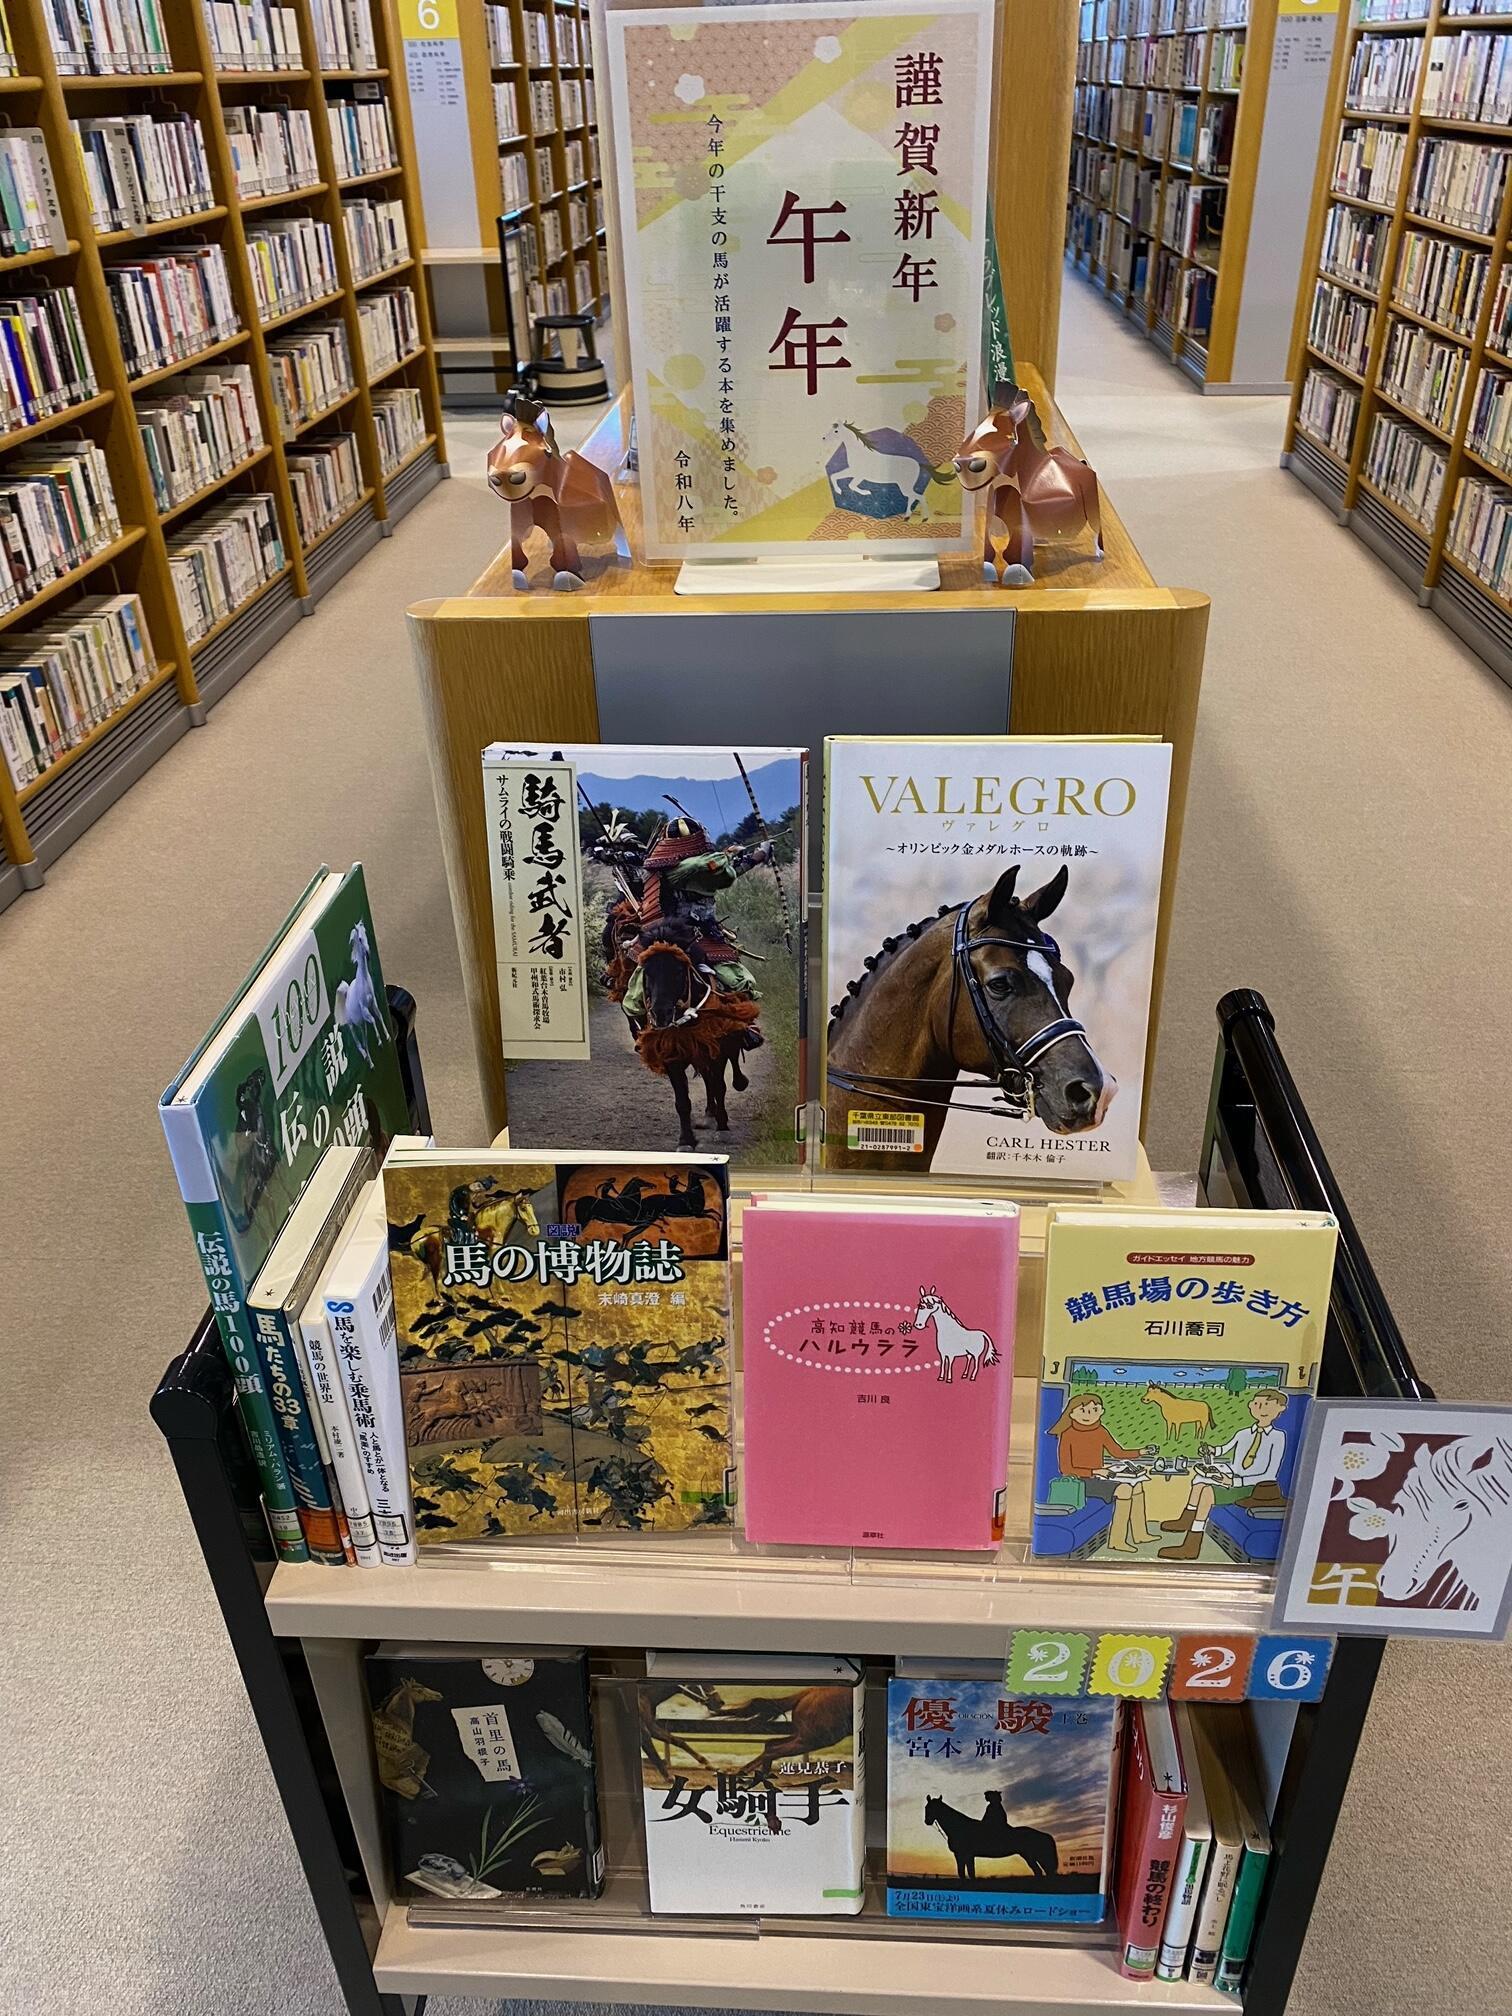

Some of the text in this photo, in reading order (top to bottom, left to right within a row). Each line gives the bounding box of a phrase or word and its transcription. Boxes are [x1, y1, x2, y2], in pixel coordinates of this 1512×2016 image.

[418, 0, 440, 30] 6
[892, 52, 943, 302] 謹賀新年
[707, 114, 739, 518] 今年の干支の馬が活躍する本を集めました。
[766, 190, 852, 395] 午年
[673, 450, 696, 534] 令和八年
[859, 775, 1137, 816] VALEGRO
[496, 774, 516, 881] サムライの戦闘騎乗
[942, 820, 1049, 832] ヴァレグロ
[518, 773, 573, 960] 騎馬武者
[271, 954, 320, 1082] 100
[986, 1136, 1112, 1152] CARL HESTER
[444, 1240, 684, 1287] 馬の博物誌
[1132, 1254, 1250, 1265] ガイドエッセイ 地方競馬の魅力
[598, 1291, 686, 1306] 末崎真澄 編
[1064, 1276, 1310, 1328] 競馬場の歩き方
[799, 1339, 920, 1358] ハルウララ
[811, 1318, 896, 1336] 高知競馬の
[1144, 1320, 1225, 1337] 石川喬司
[256, 1313, 301, 1431] 馬たちの33章
[309, 1339, 335, 1403] 競馬の世界史
[335, 1316, 376, 1428] 馬を楽しむ乗馬術
[1310, 1563, 1378, 1607] 午
[470, 1716, 490, 1766] 高山羽根子
[902, 1696, 958, 1732] 優
[994, 1699, 1054, 1735] 駿
[482, 1712, 511, 1772] 首里の馬
[906, 1736, 1004, 1760] 宮本 輝
[648, 1772, 850, 1827] 女騎手
[1142, 1859, 1170, 1928] 競馬の終わり
